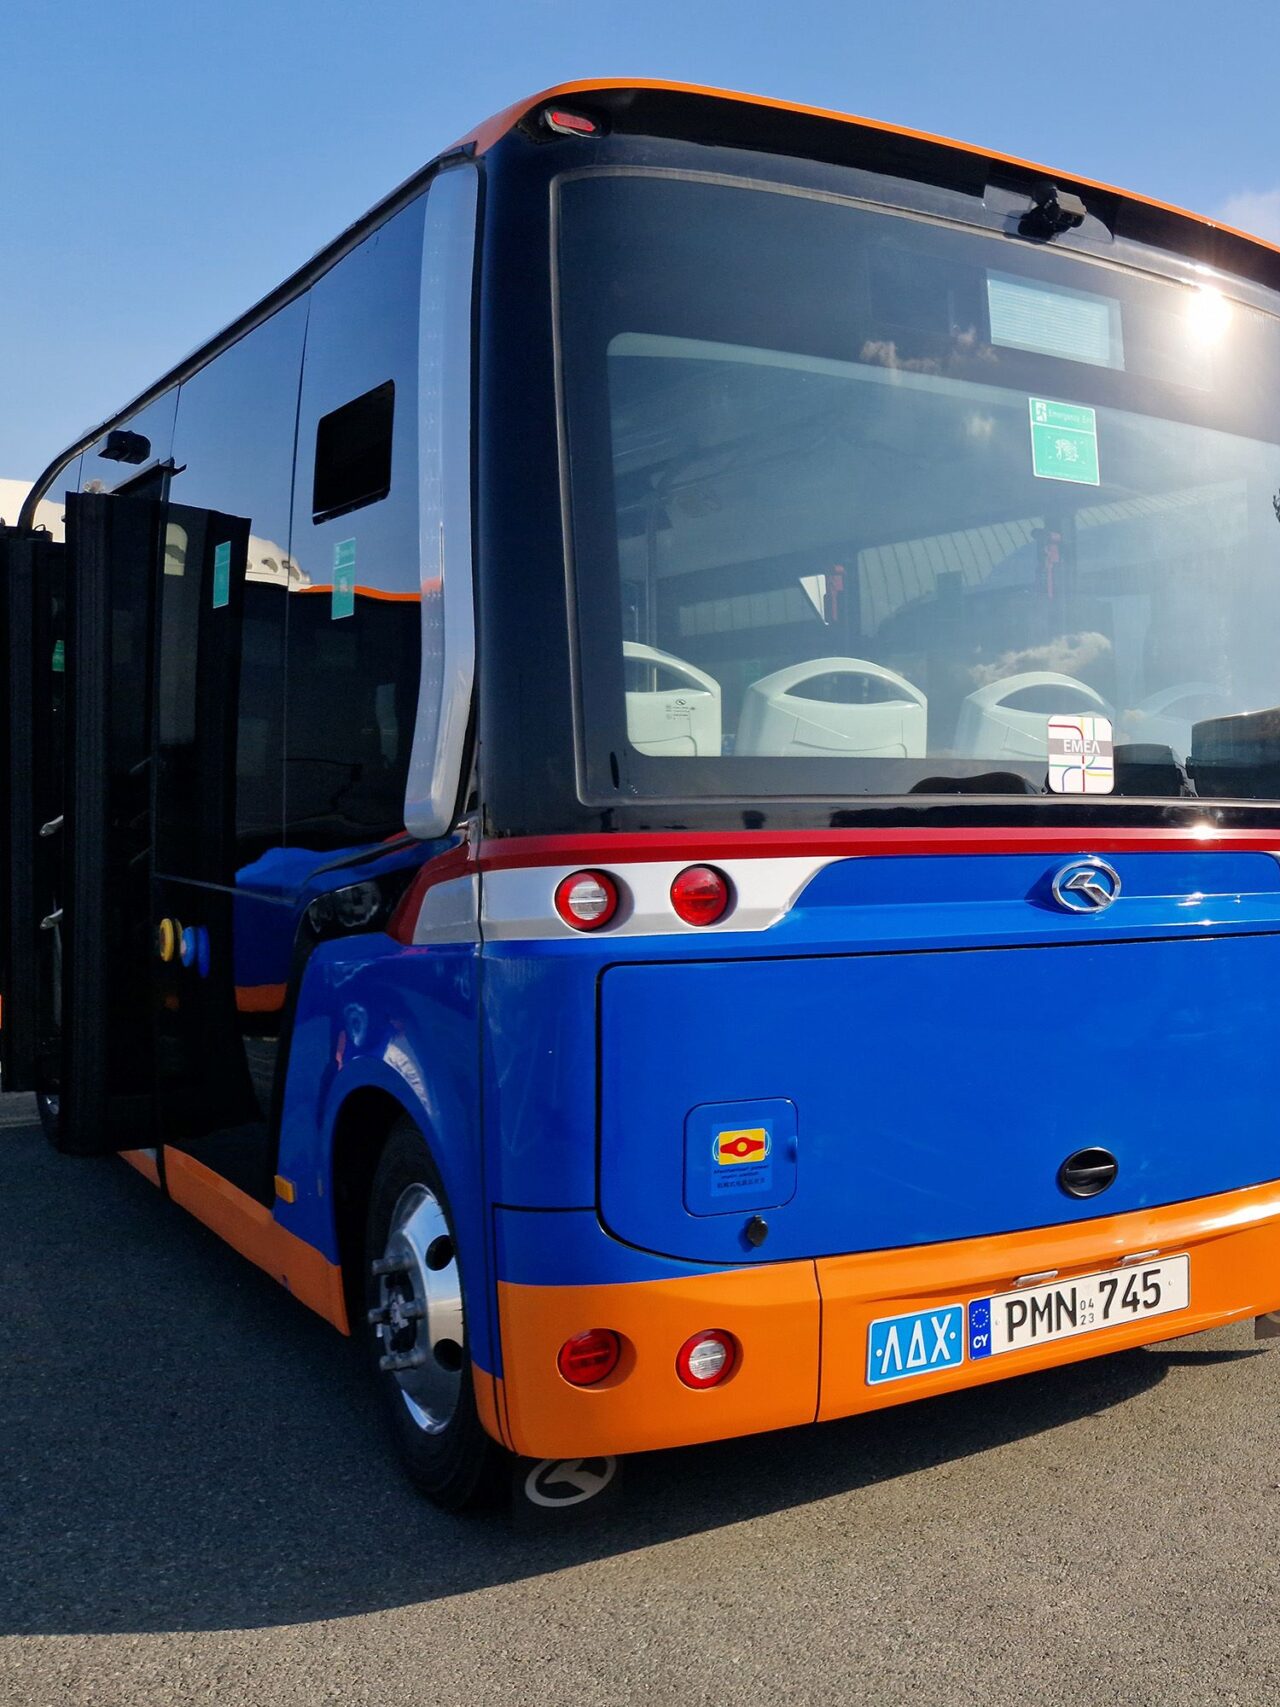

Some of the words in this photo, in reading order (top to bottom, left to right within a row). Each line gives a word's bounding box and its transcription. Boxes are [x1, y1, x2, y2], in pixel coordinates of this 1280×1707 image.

[1005, 1286, 1078, 1343] PMN
[1098, 1267, 1162, 1320] 745
[1079, 1299, 1094, 1311] 04
[1079, 1312, 1095, 1326] 23
[972, 1333, 989, 1349] CY
